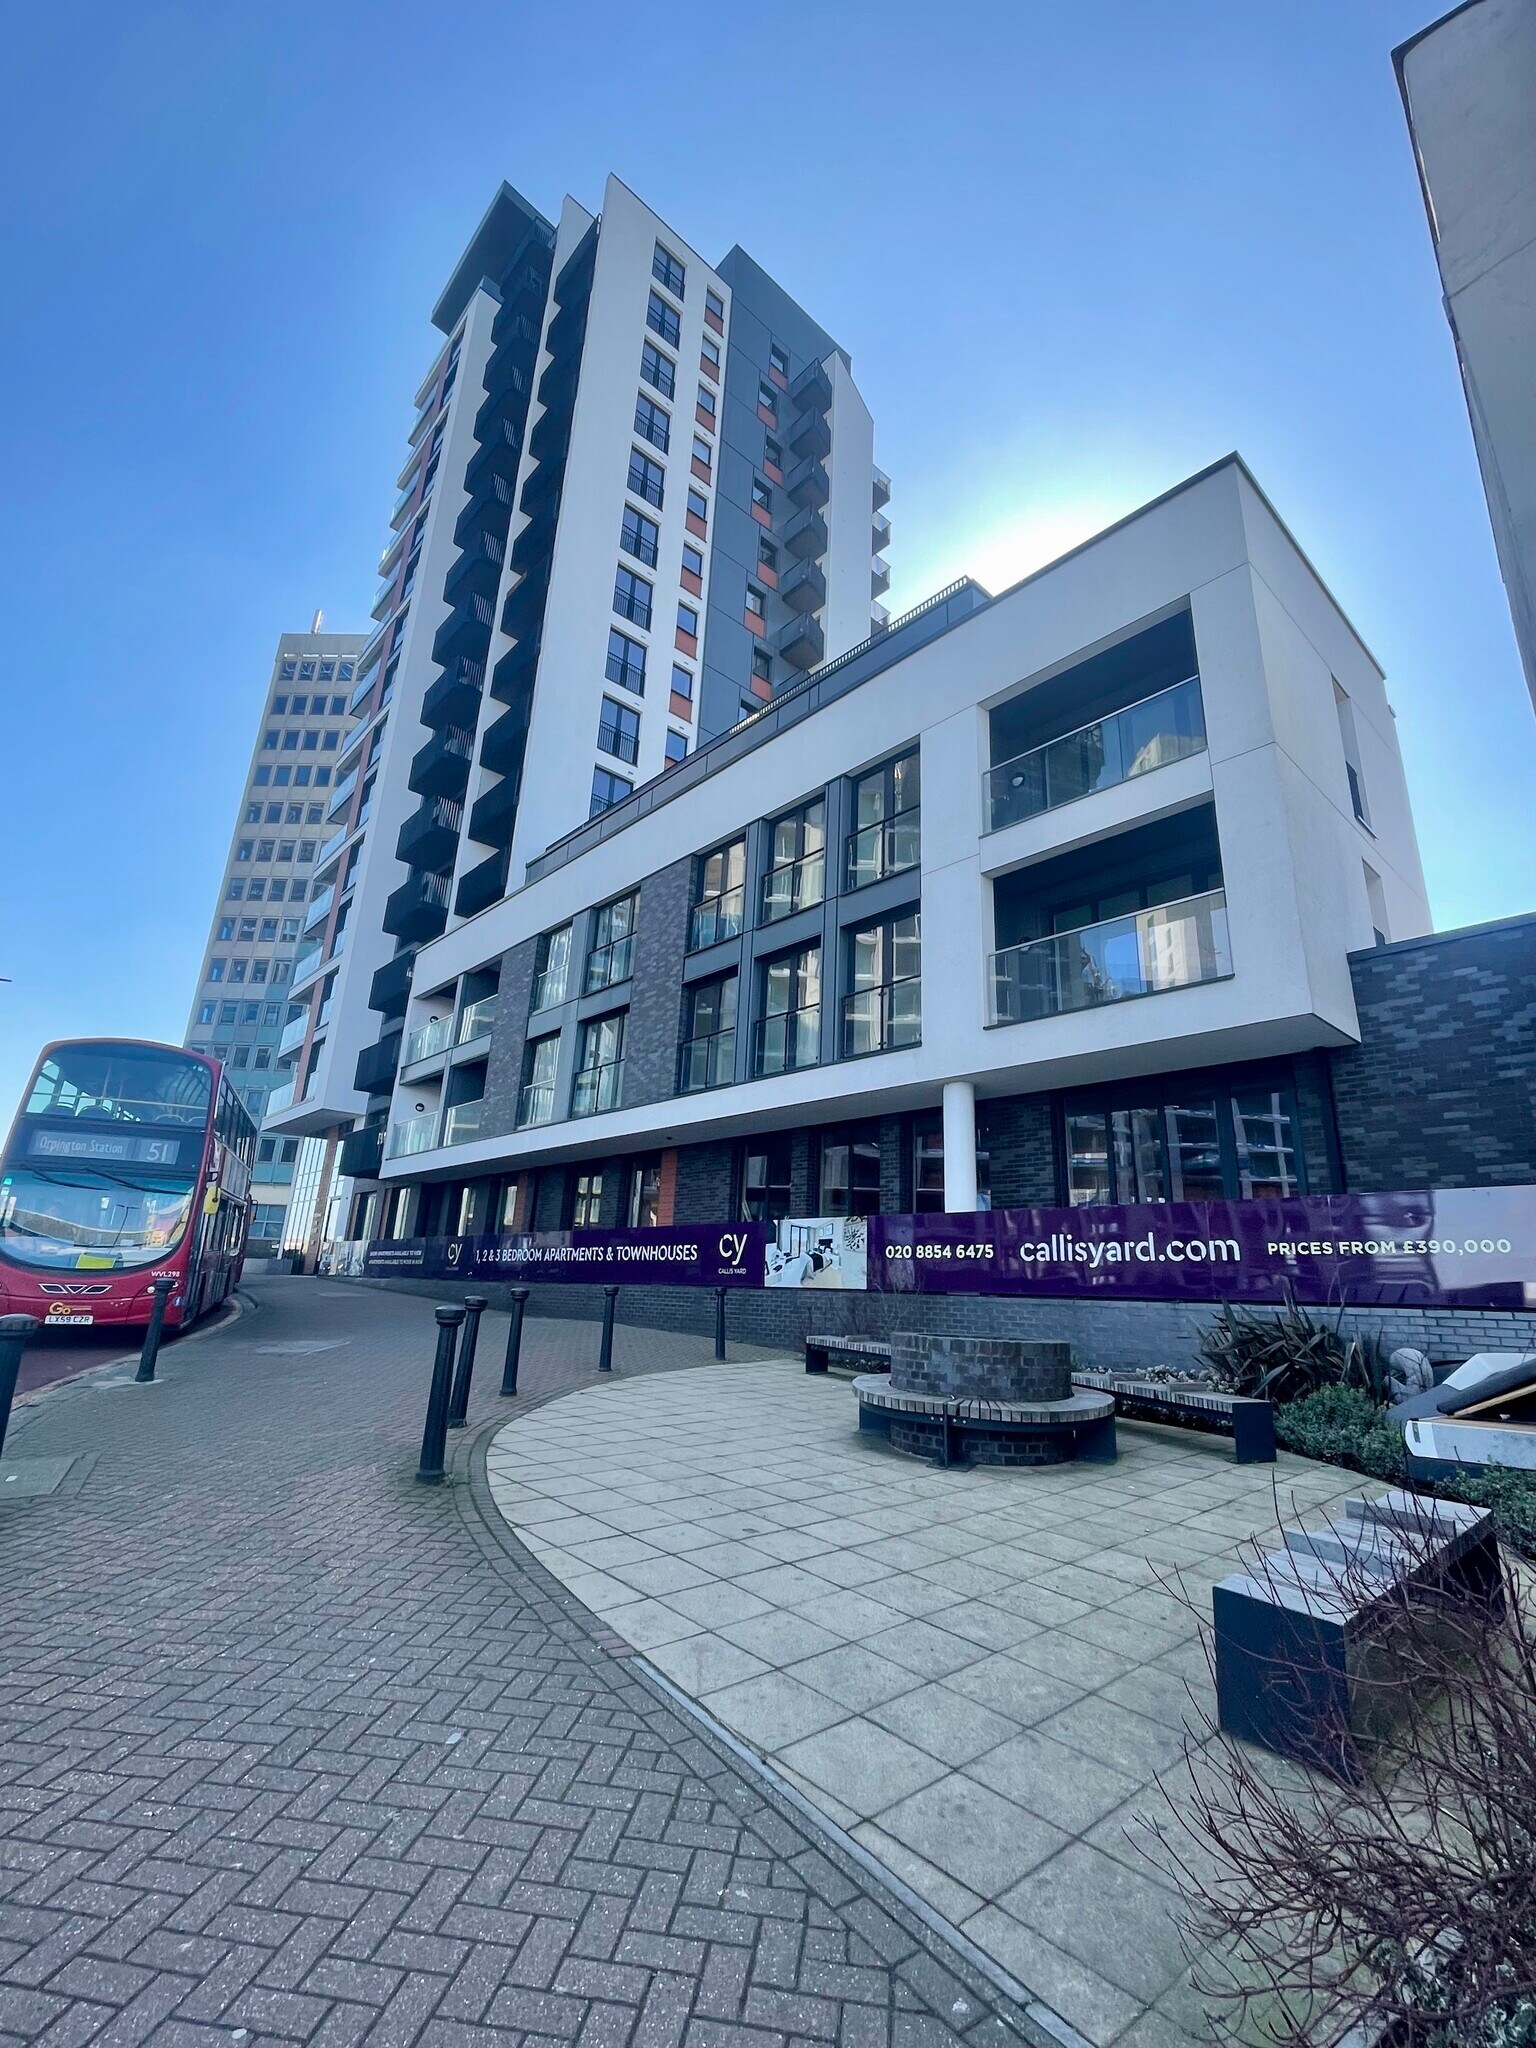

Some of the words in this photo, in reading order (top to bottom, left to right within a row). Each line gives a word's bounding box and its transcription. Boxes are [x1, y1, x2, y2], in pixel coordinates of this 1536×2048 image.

[89, 1139, 123, 1155] Station
[146, 1142, 169, 1162] 51
[482, 1249, 488, 1262] 2
[488, 1249, 495, 1262] &
[495, 1248, 501, 1262] 3
[501, 1248, 543, 1262] BEDROOM
[543, 1247, 604, 1262] APARTMENTS
[605, 1246, 614, 1262] &
[616, 1244, 698, 1261] TOWNHOUSES
[884, 1244, 913, 1259] 020
[915, 1244, 953, 1259] 8854
[955, 1244, 995, 1259] 6475
[1019, 1231, 1242, 1268] callisyard.com
[1266, 1240, 1333, 1256] PRICES
[1337, 1240, 1397, 1255] FROM
[1401, 1238, 1512, 1256] £390,000
[717, 1267, 734, 1275] CALLIS
[734, 1267, 747, 1275] YARD
[73, 1316, 90, 1324] CZR
